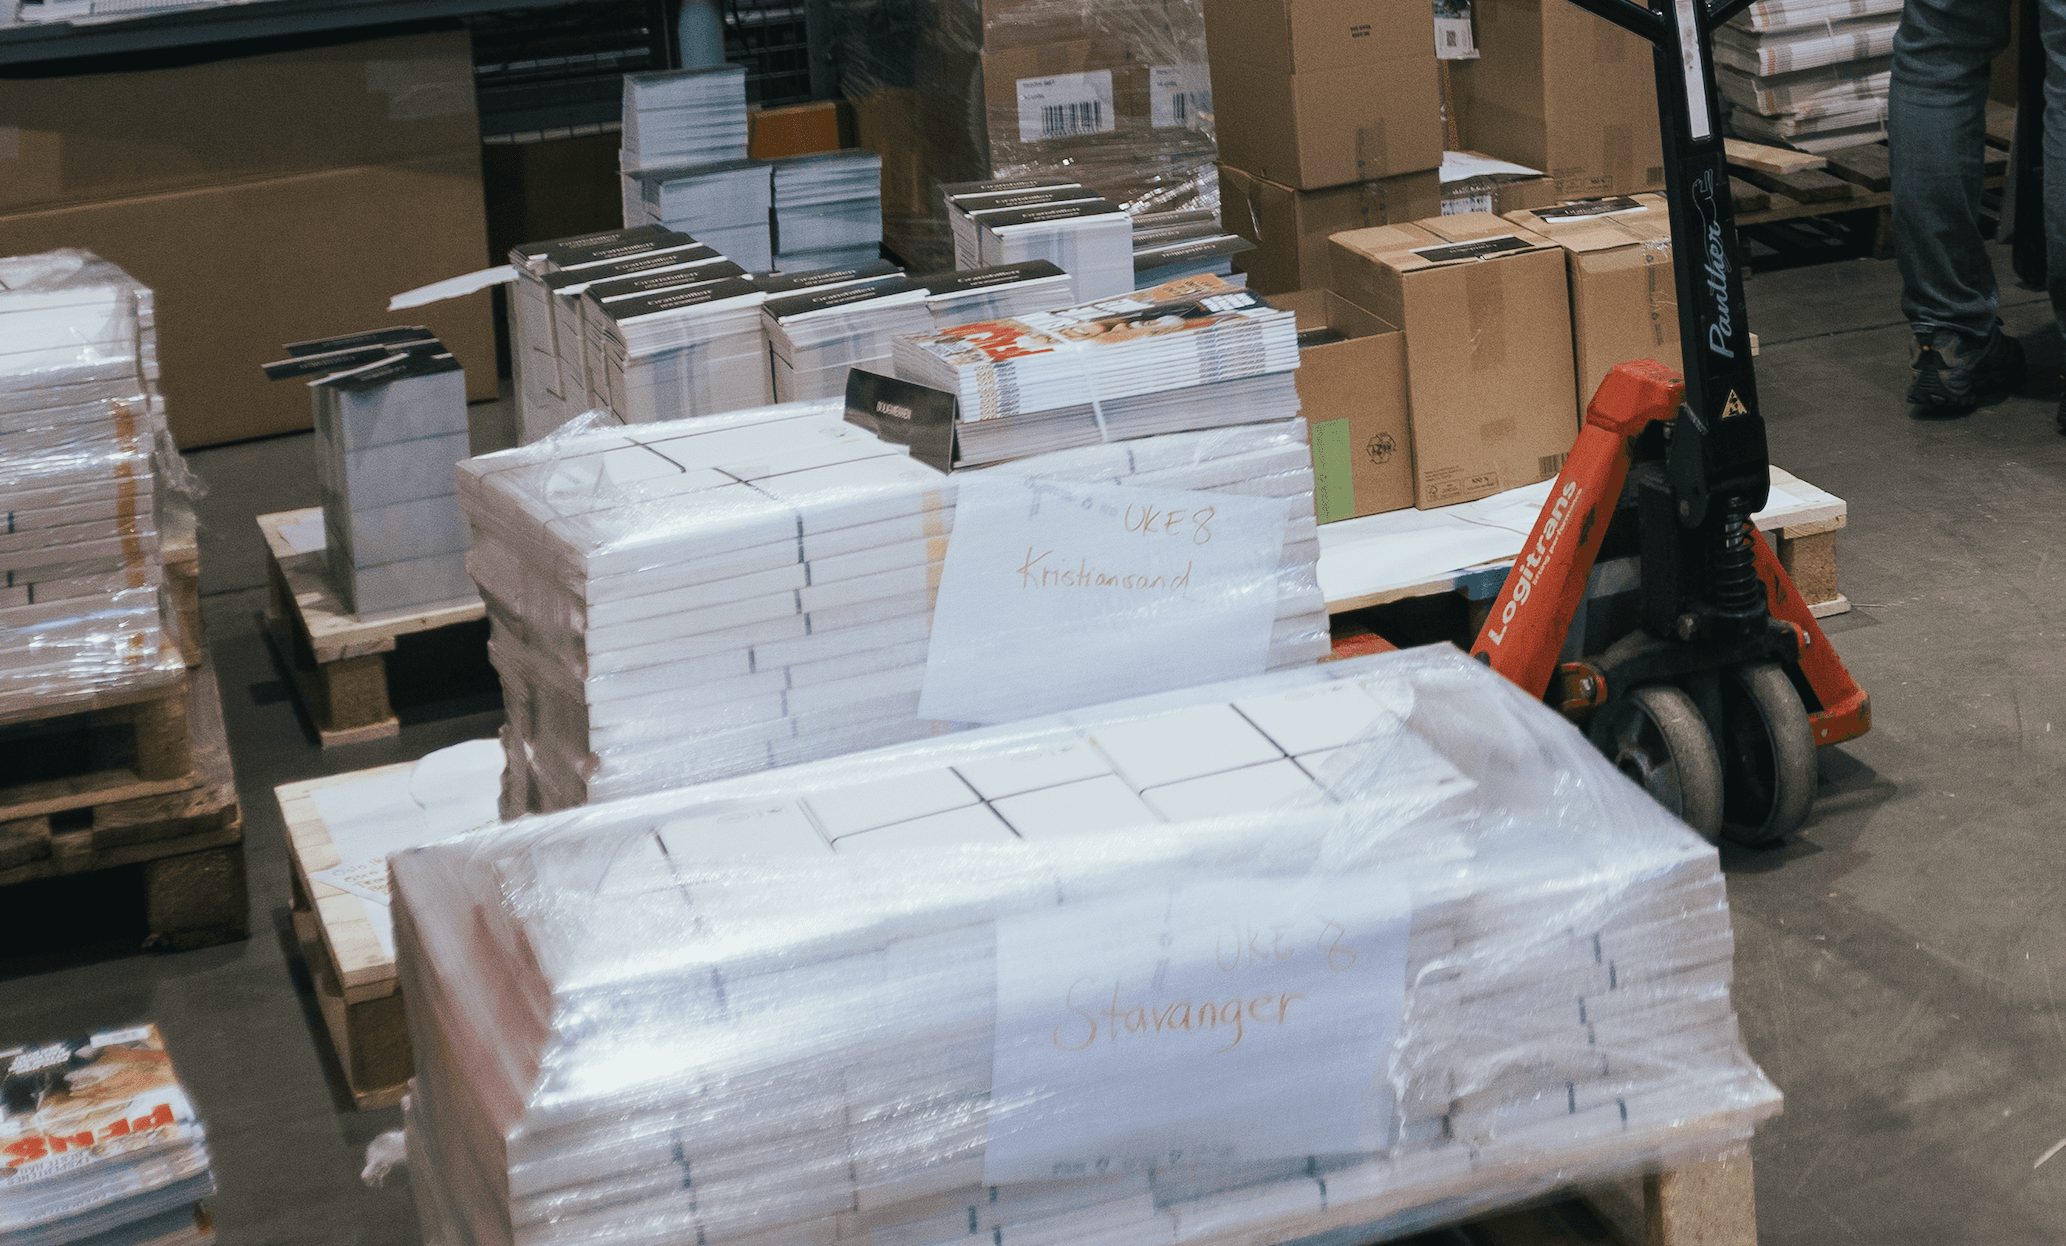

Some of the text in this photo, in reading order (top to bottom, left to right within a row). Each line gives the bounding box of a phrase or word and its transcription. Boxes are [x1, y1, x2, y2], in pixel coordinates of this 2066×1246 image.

[1704, 219, 1735, 359] Panther
[1124, 502, 1216, 545] UKE 8
[1016, 545, 1194, 593] Kristiansand
[1487, 480, 1577, 646] Logitrans
[1215, 916, 1358, 974] UKE 8
[1052, 976, 1308, 1055] Stavanger
